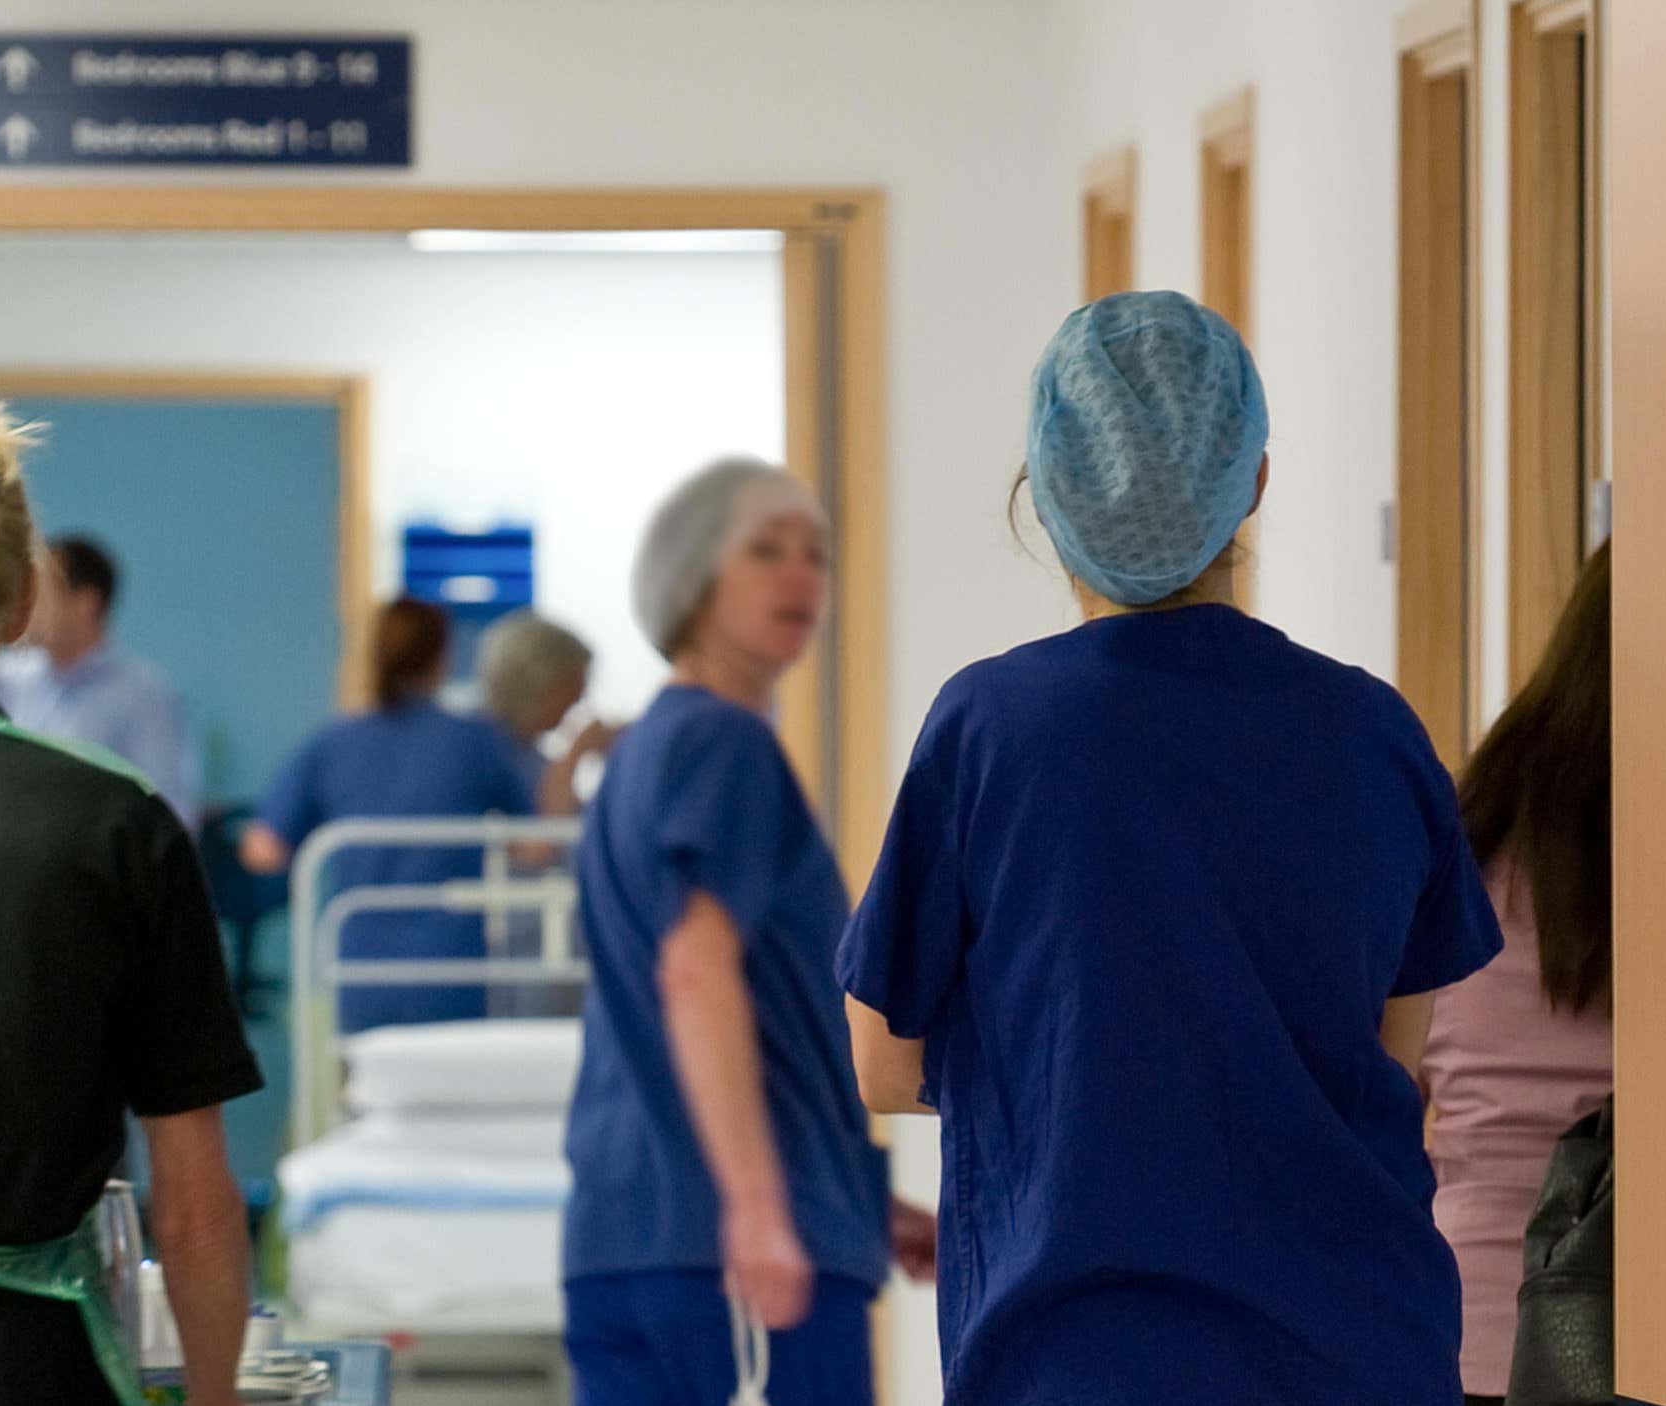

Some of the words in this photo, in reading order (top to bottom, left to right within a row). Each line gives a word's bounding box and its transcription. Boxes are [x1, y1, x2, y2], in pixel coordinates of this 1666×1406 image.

[74, 52, 218, 86] Bedrooms
[221, 52, 287, 86] Blue
[74, 119, 218, 153] Bedrooms
[221, 119, 284, 153] Red
